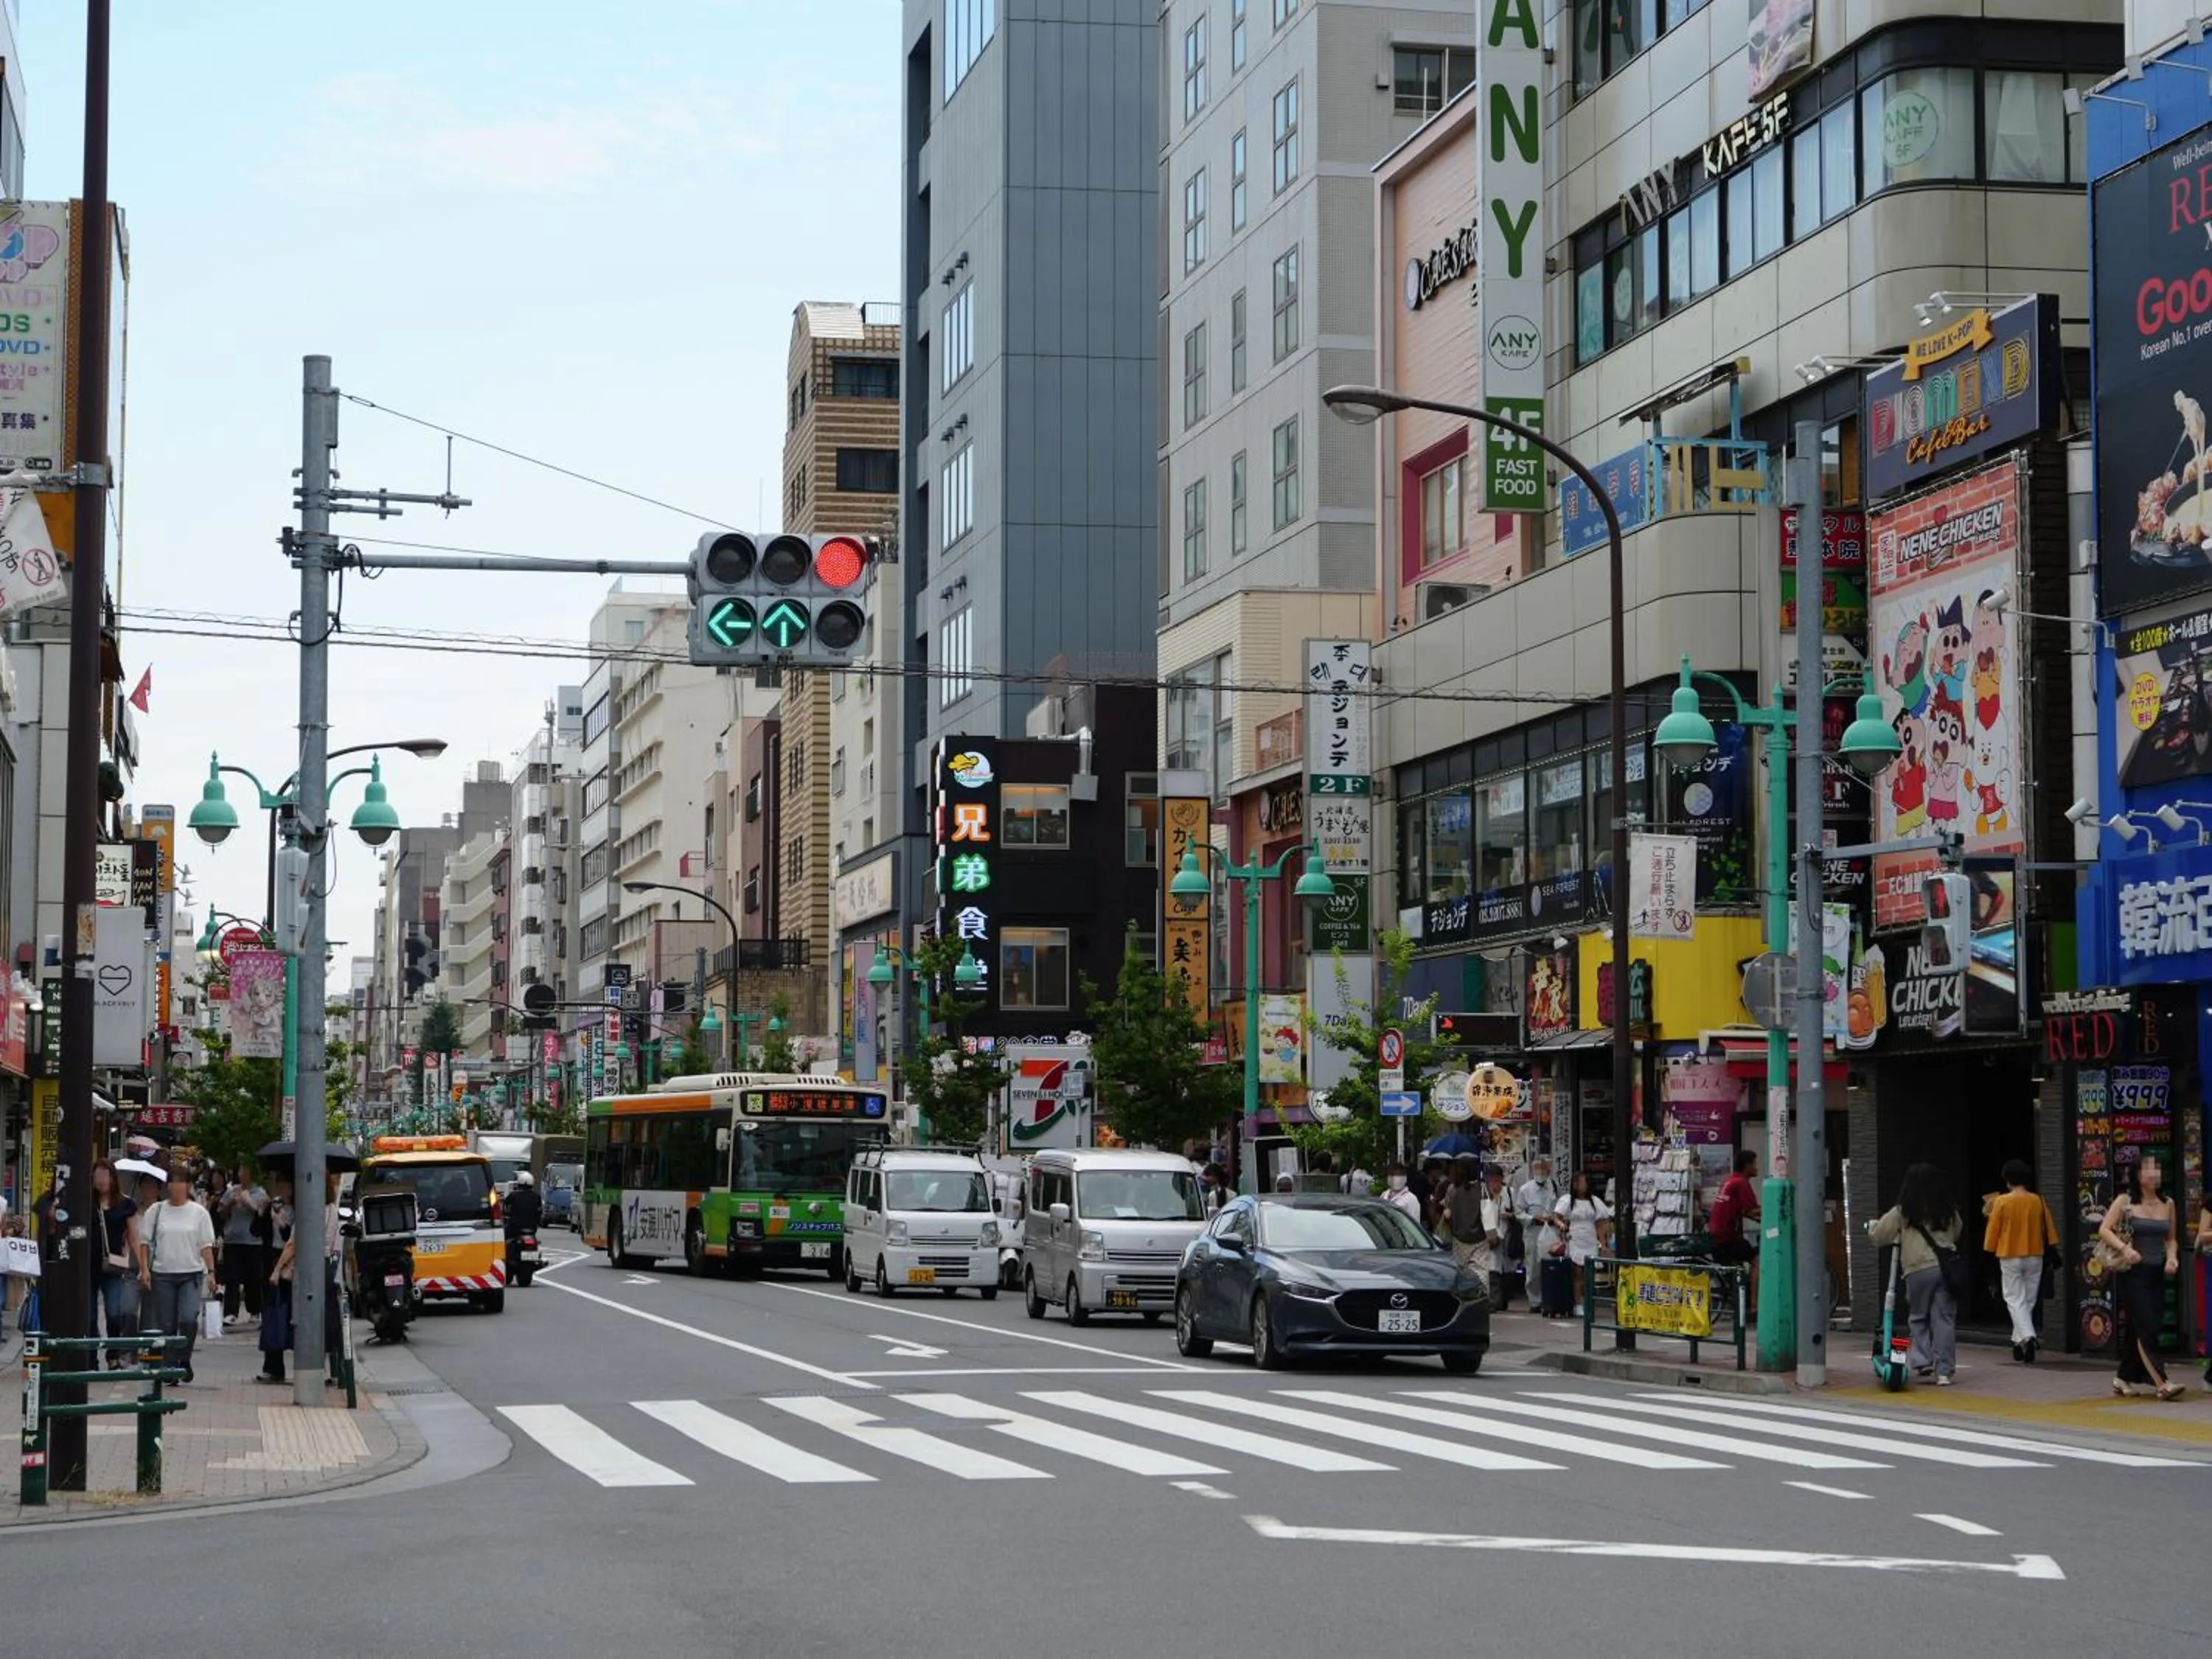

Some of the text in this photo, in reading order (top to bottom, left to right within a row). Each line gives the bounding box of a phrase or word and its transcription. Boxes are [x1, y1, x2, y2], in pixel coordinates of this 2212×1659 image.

[1885, 105, 1927, 130] ANY
[1487, 0, 1540, 279] ANY
[1620, 159, 1680, 234] ANY
[1491, 332, 1537, 349] ANY
[1927, 337, 1947, 354] LOVE
[2141, 337, 2170, 361] Korean
[1872, 336, 2029, 455] DIAMOND
[1496, 459, 1537, 475] FAST
[1495, 479, 1537, 495] FOOD
[1899, 526, 1939, 563] NENE
[1938, 501, 2004, 548] CHICKEN
[2135, 680, 2154, 695] DVD
[1319, 777, 1364, 793] 2F
[1790, 872, 1865, 885] CCKEN
[2045, 1011, 2116, 1062] RED
[2143, 1001, 2159, 1054] RED
[2112, 1085, 2167, 1107] ¥999
[1438, 1102, 1468, 1112] テジョン
[1387, 1318, 1419, 1331] 25-25
